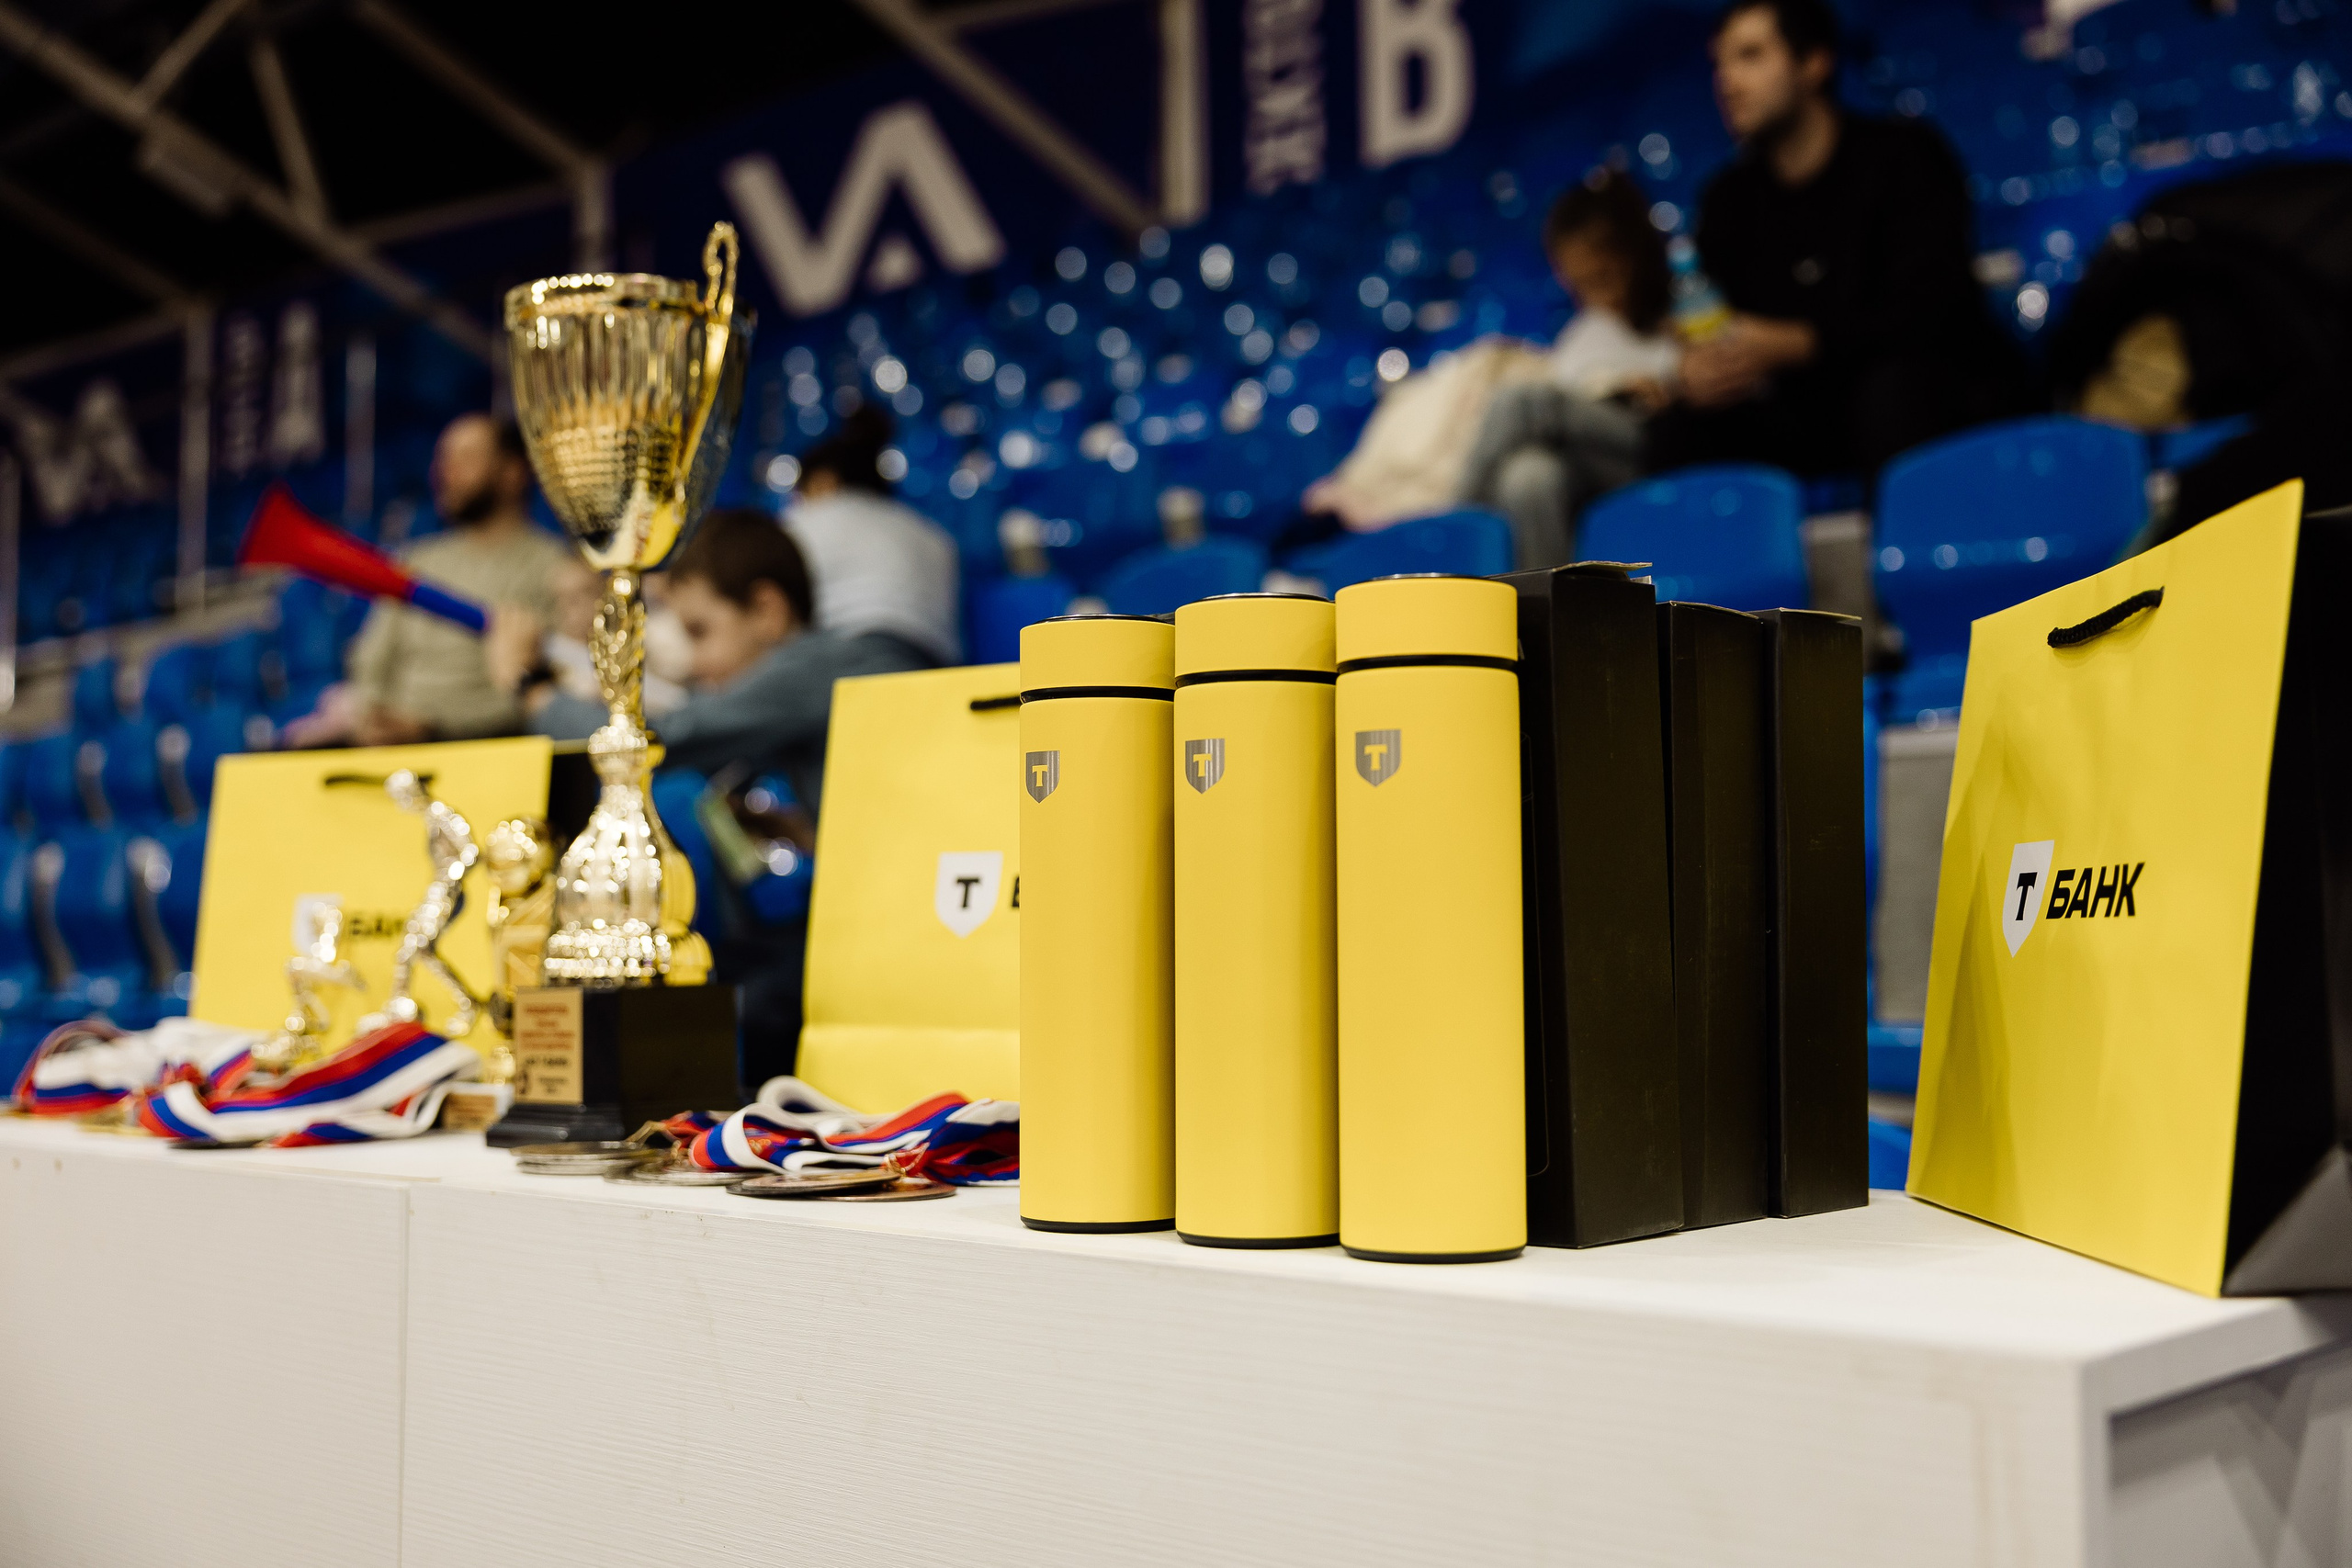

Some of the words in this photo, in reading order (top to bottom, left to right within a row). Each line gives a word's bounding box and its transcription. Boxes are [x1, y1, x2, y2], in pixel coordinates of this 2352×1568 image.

[1193, 753, 1212, 777] Т
[1364, 744, 1387, 771] Т
[1032, 764, 1048, 787] Т
[956, 877, 981, 909] Т
[2045, 862, 2145, 919] БАНК
